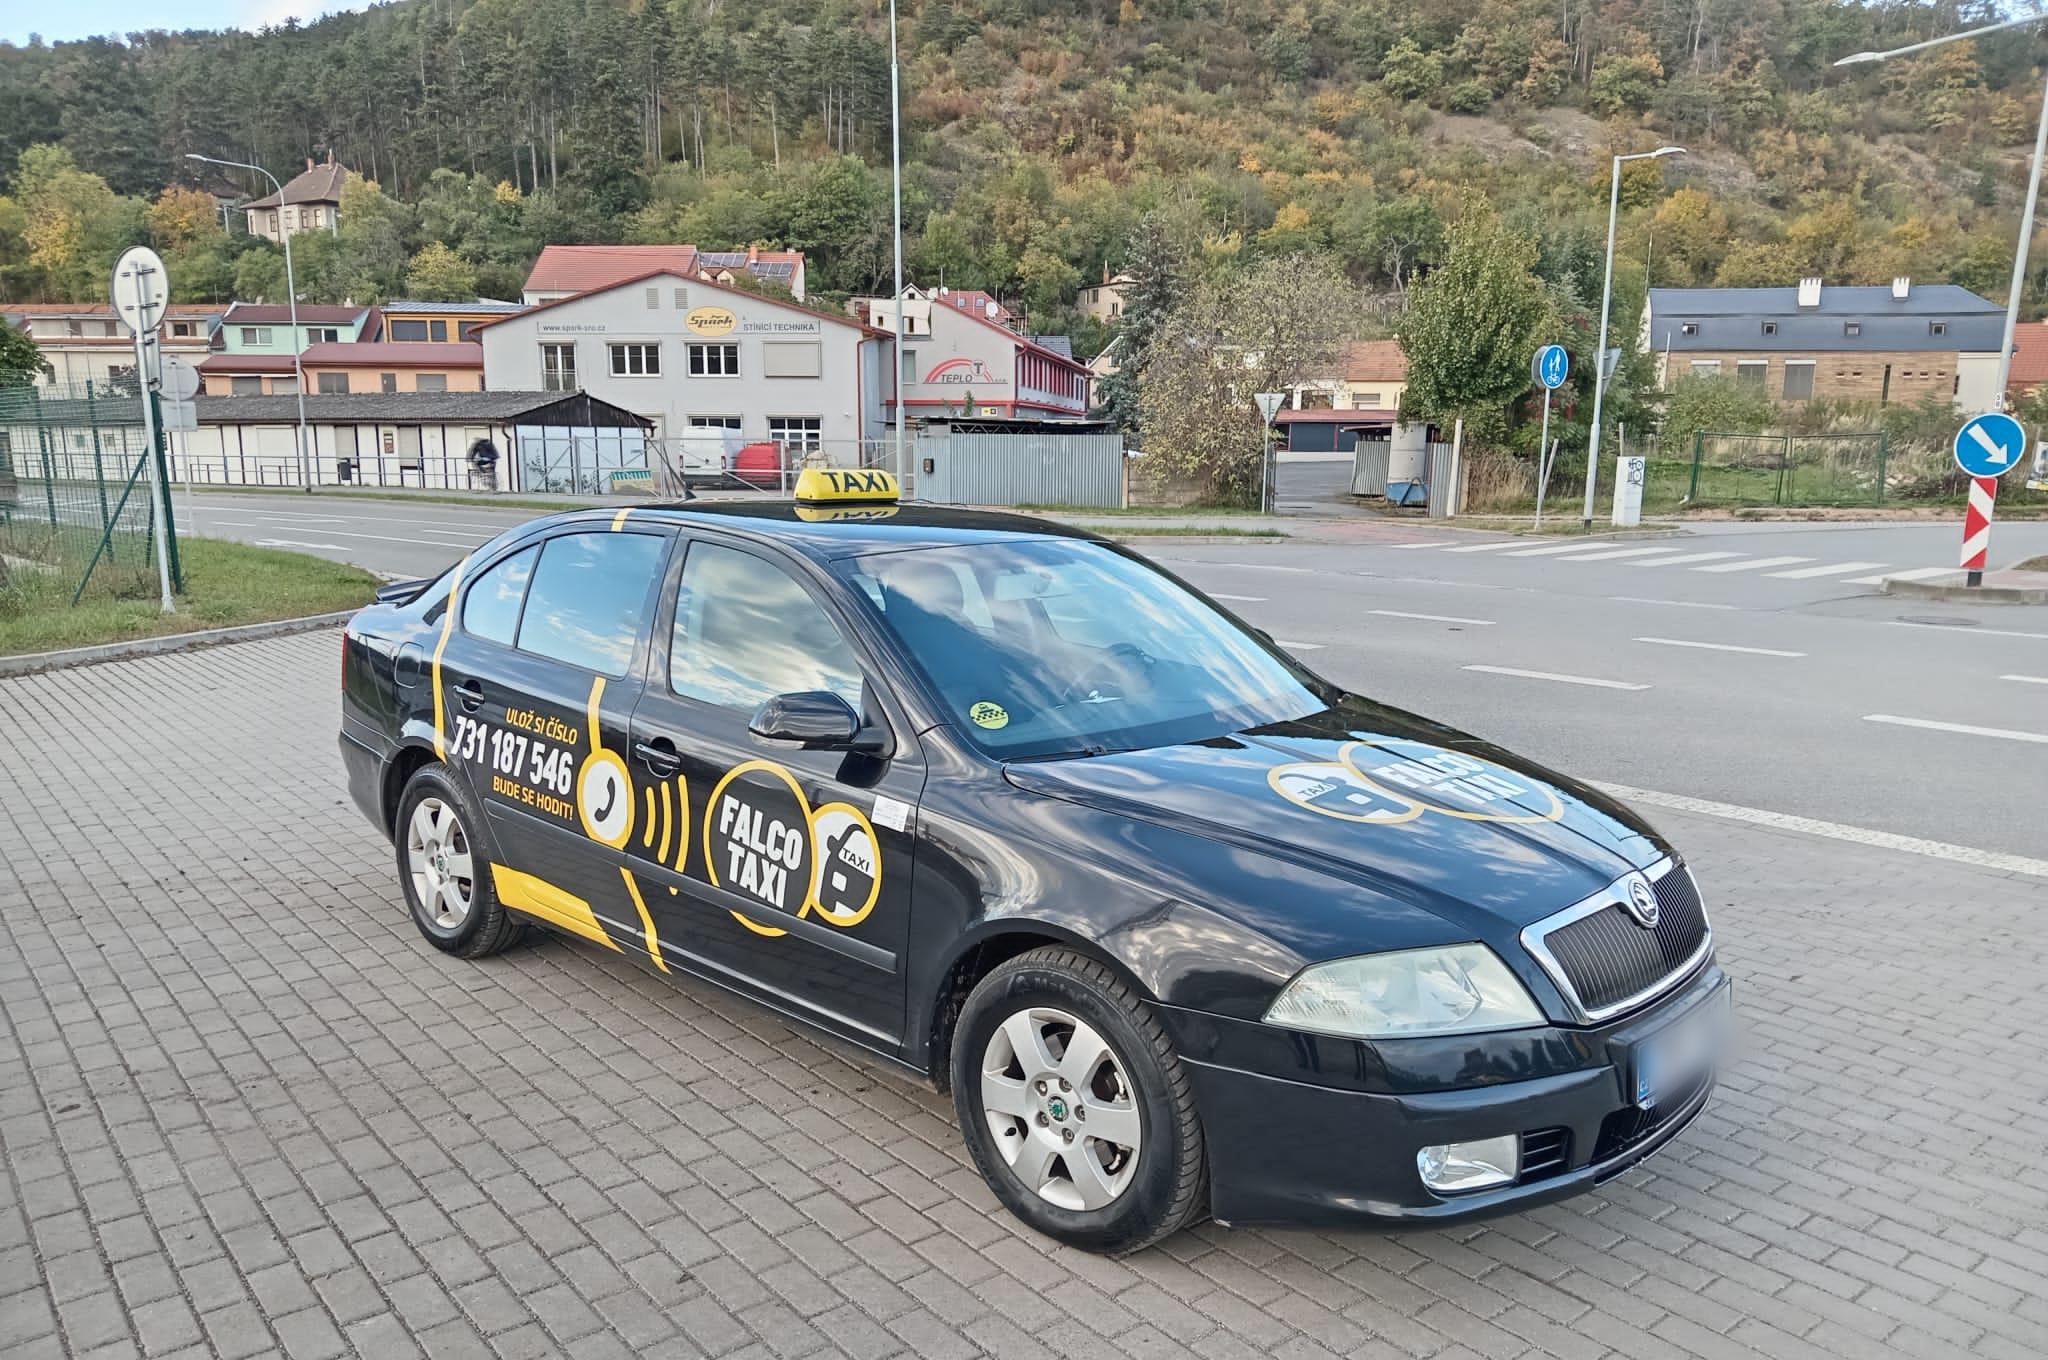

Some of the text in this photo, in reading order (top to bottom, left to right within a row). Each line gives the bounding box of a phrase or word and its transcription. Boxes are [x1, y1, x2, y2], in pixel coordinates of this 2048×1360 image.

[774, 322, 815, 331] TECHNIKA
[941, 374, 973, 383] TEPLO
[974, 363, 983, 374] T
[821, 472, 890, 493] TAXI
[506, 707, 578, 745] ULOŽ SI ČÍSLO
[450, 715, 573, 795] 731 187 546
[493, 775, 574, 820] BUDE SE HODIT!
[1298, 782, 1332, 799] TAXI
[719, 794, 803, 871] FALCO
[842, 847, 870, 873] TAXI
[727, 841, 787, 909] TAXI
